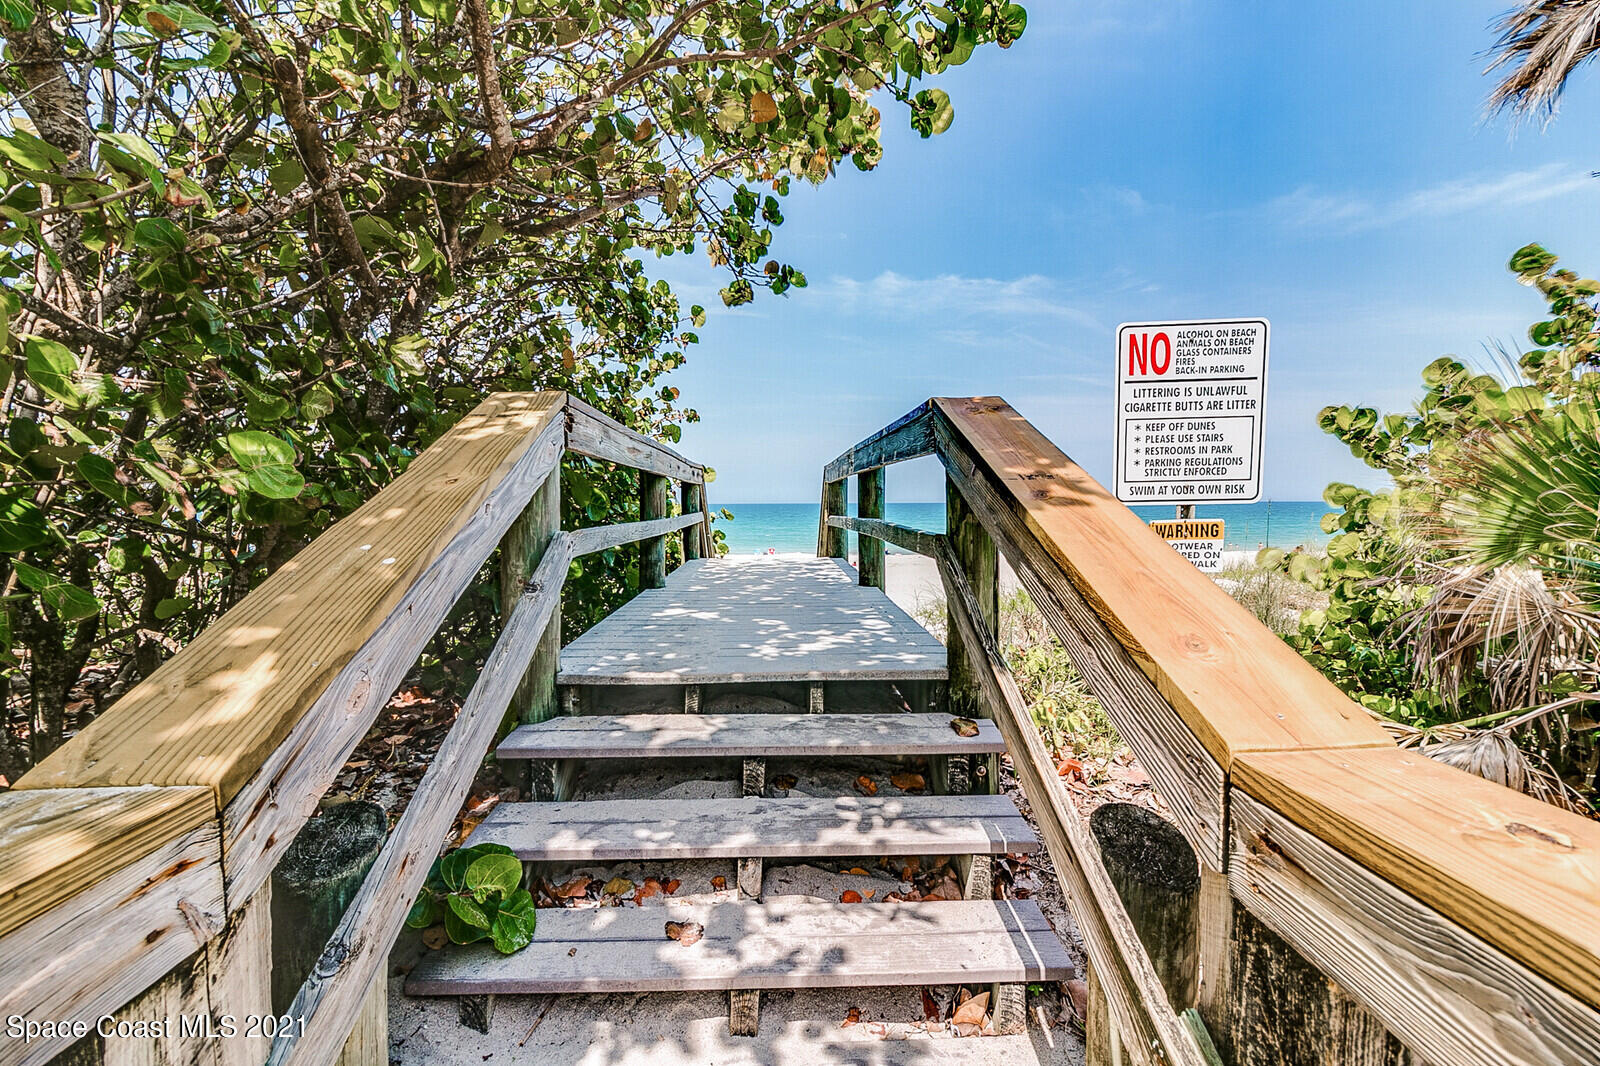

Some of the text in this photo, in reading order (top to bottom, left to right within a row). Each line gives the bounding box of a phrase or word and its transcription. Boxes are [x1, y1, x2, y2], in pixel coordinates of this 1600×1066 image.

[1177, 331, 1214, 339] ALCOHOL
[1231, 329, 1256, 337] BEACH
[1177, 339, 1211, 347] ANIMALS
[1129, 332, 1171, 376] NO
[1176, 347, 1251, 357] GLASS CONTAINERS
[1175, 365, 1245, 375] BACK-IN PARKING
[1133, 386, 1247, 398] LITTERING IS UNLAWFUL
[1125, 400, 1256, 412] CIGARETTE BUTTS ARE LITTER
[1146, 422, 1215, 431] KEEP OFF DUNES
[1145, 434, 1223, 443] PLEASE USE STAIRS
[1145, 446, 1232, 455] RESTROOMS IN PARK
[1145, 457, 1243, 467] PARKING REGULATIONS
[1145, 467, 1227, 477] STRICTLY ENFORCED
[1130, 485, 1245, 496] SWIM AT YOUR OWN RISK
[1155, 524, 1219, 538] WARNING
